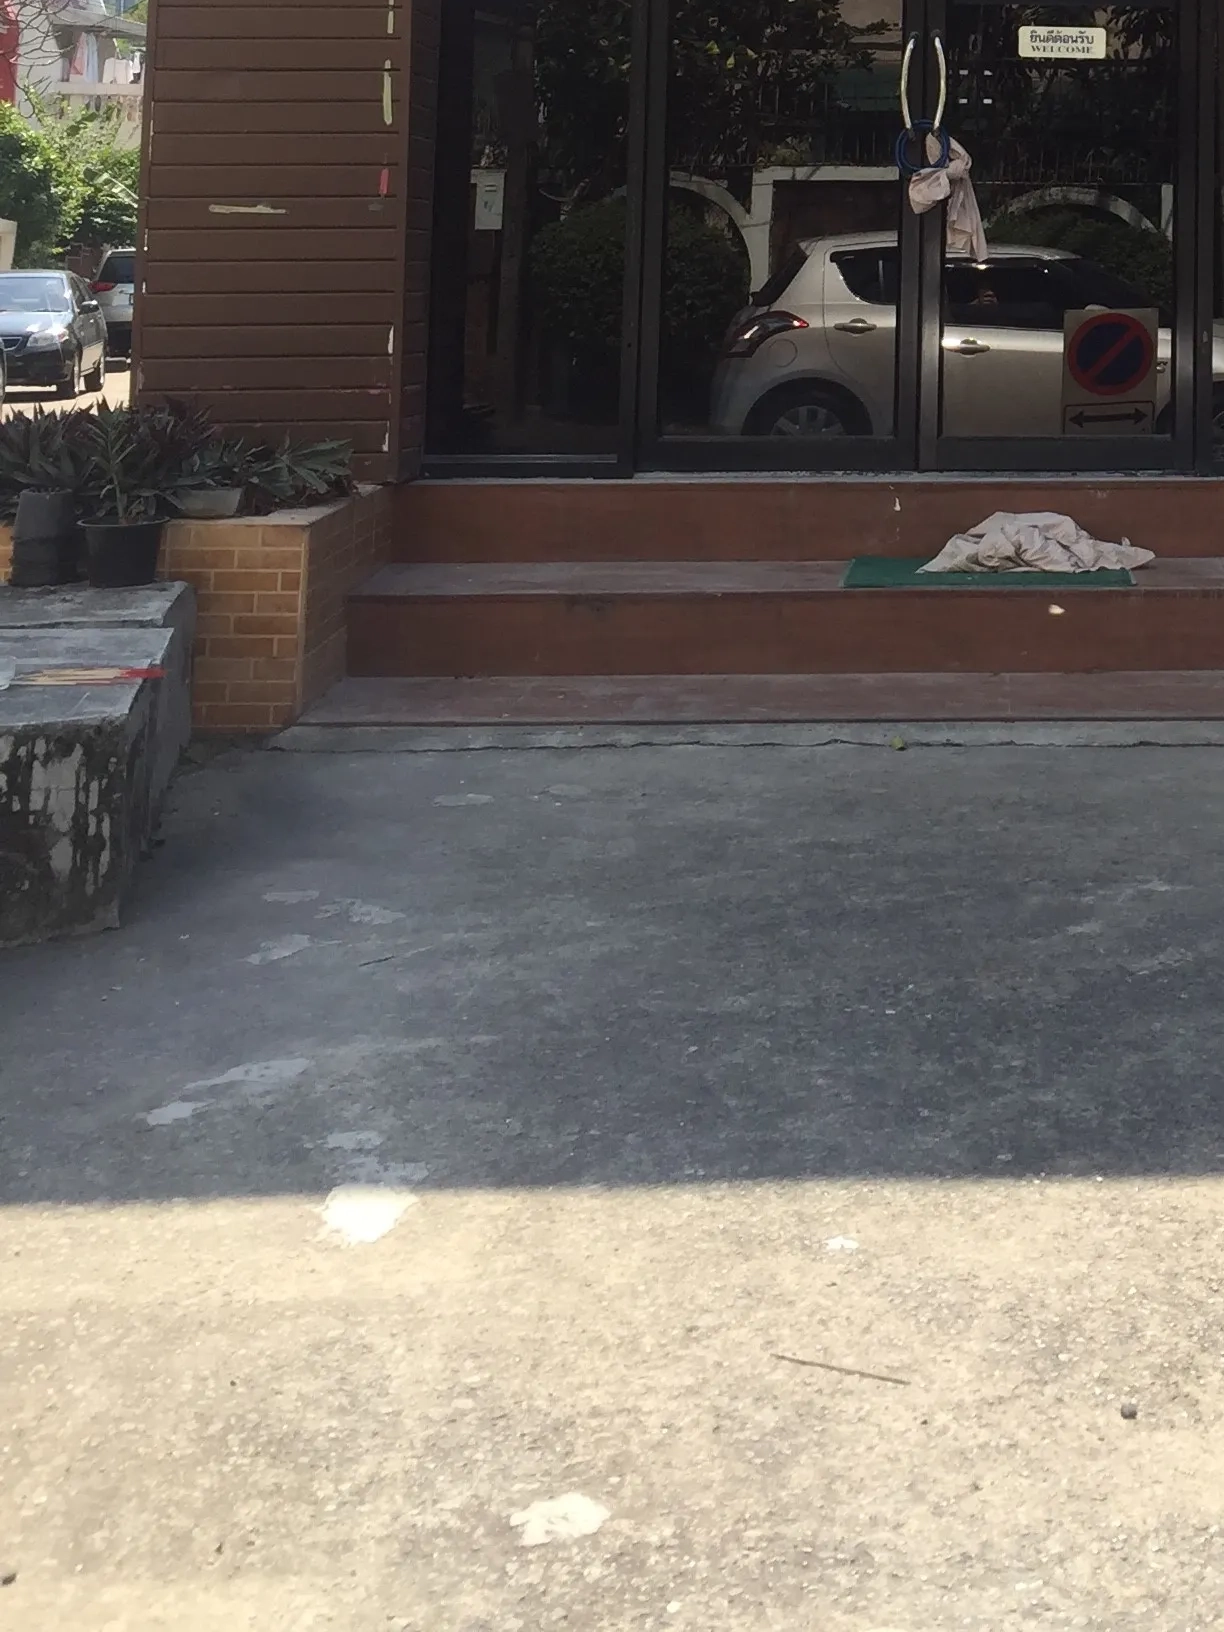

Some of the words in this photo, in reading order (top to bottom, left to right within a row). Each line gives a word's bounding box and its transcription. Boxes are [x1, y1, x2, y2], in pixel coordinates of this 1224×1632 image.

[1029, 29, 1094, 45] ยินดีต้อนรับ
[1031, 45, 1094, 54] WELCOME
